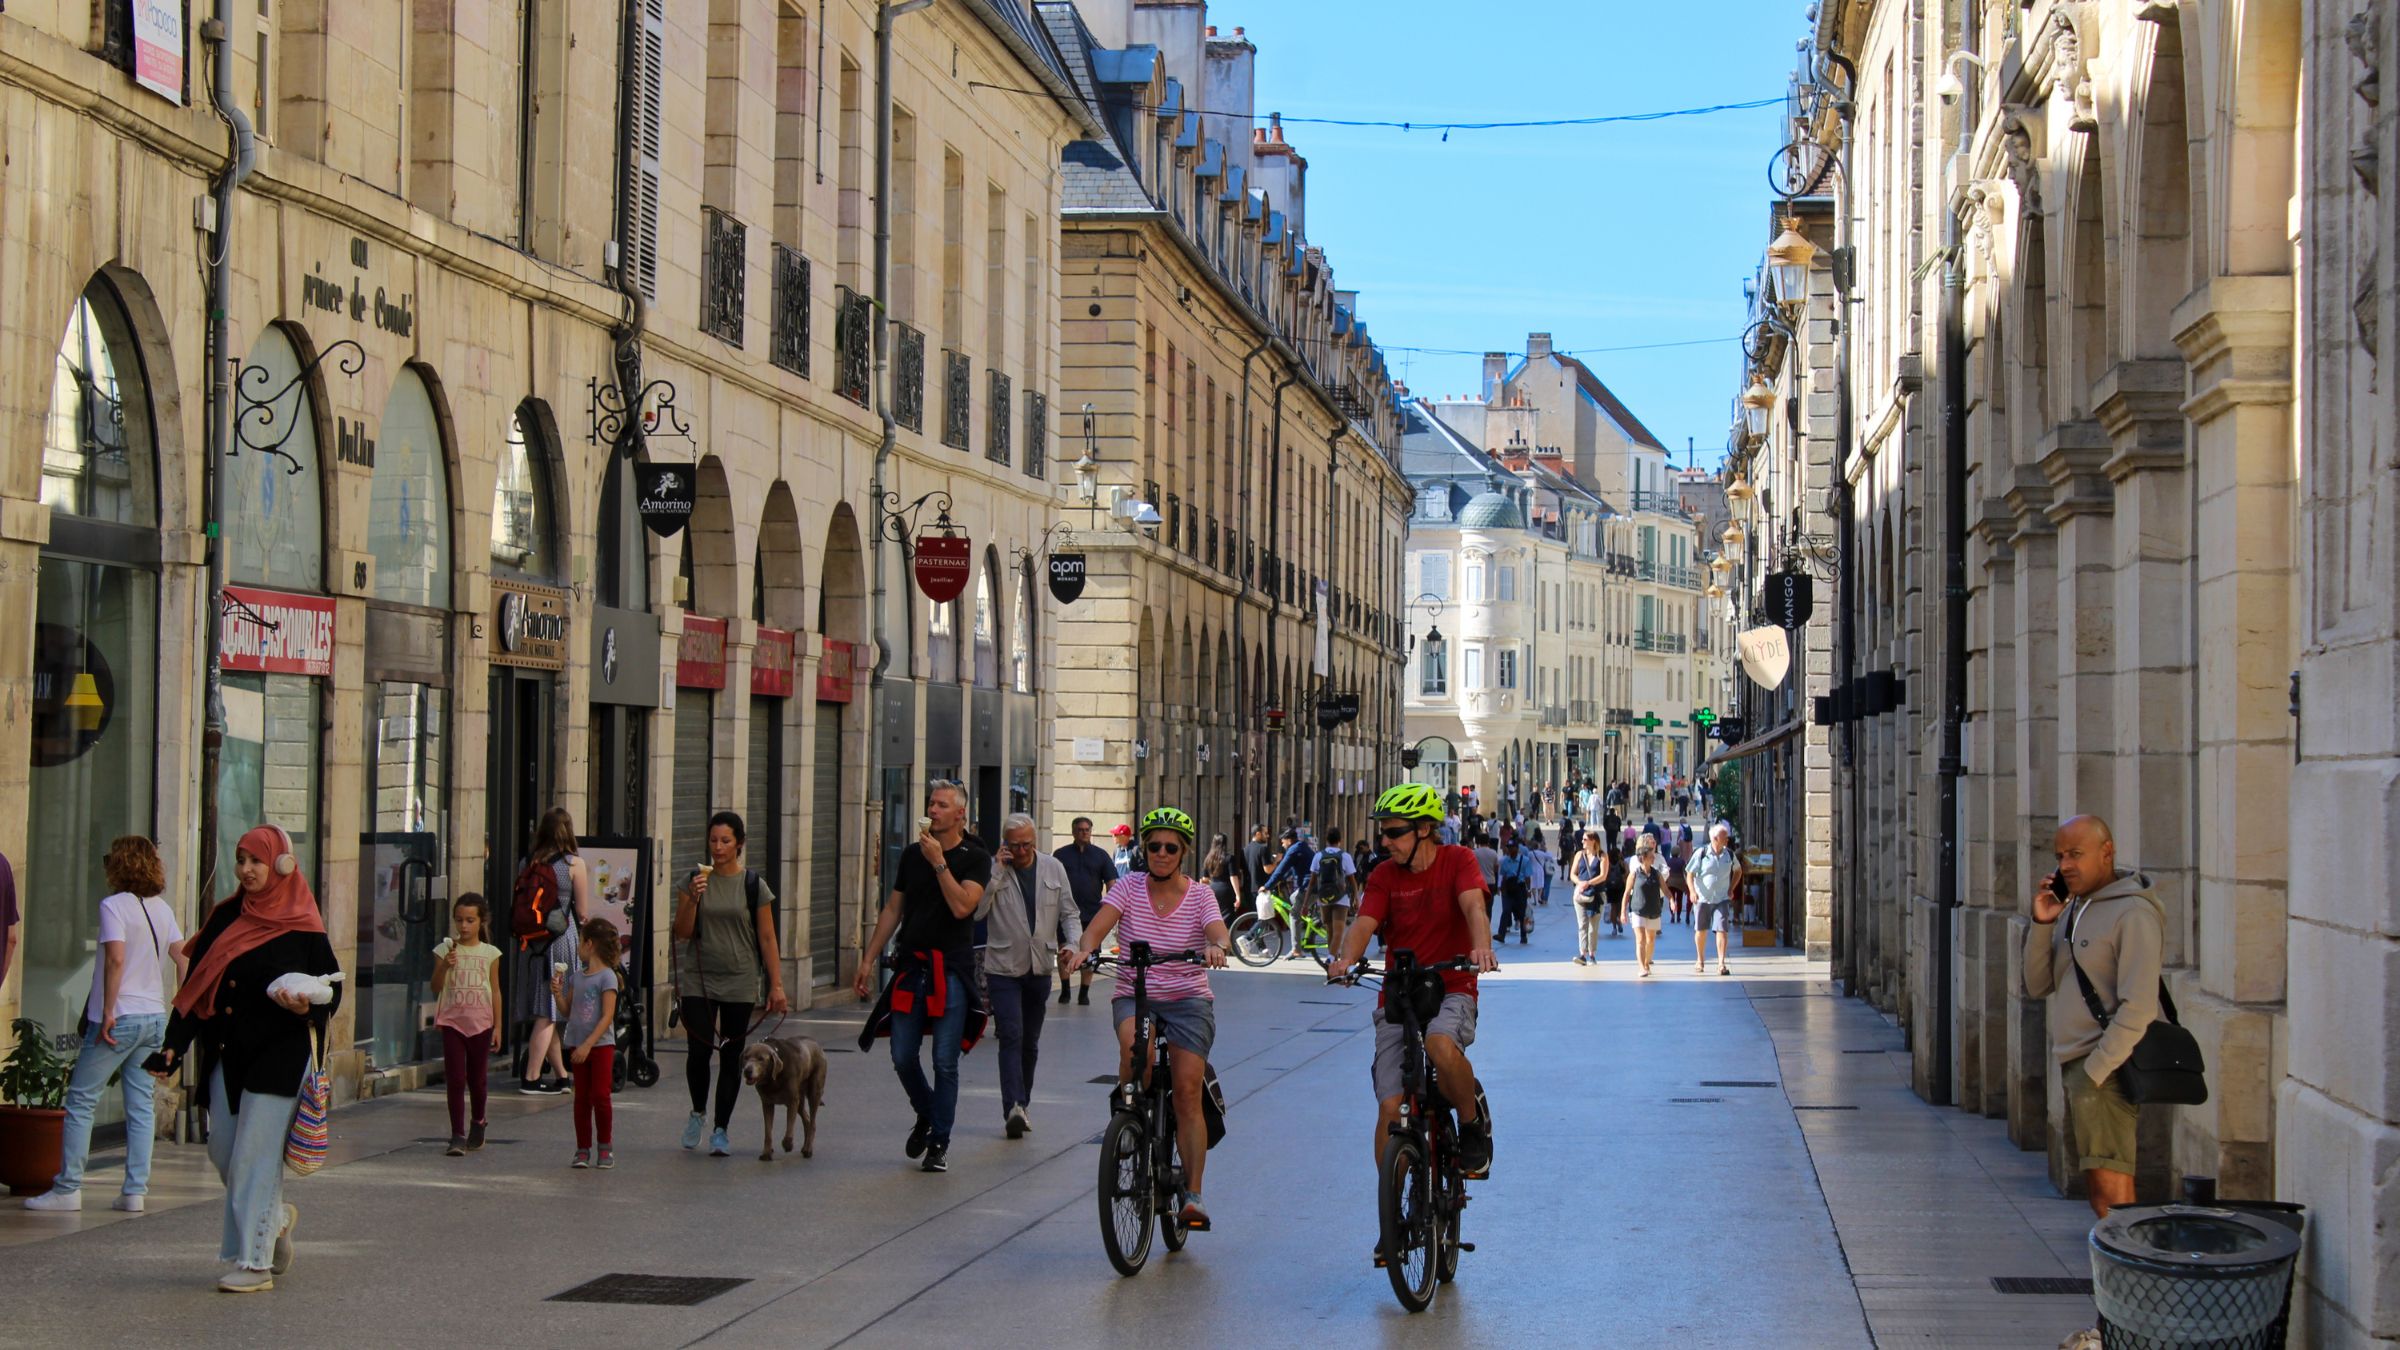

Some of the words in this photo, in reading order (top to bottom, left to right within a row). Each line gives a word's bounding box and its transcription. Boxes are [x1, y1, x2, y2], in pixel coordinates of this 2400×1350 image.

[351, 236, 369, 270] au
[301, 260, 344, 318] prince
[349, 275, 366, 323] de
[374, 285, 413, 338] Condé
[640, 497, 692, 510] Amorino
[354, 560, 367, 590] 88
[918, 558, 967, 567] PASTERNAK
[1050, 561, 1084, 577] apm
[521, 593, 563, 641] Amorino
[1784, 576, 1794, 629] MANGO
[220, 600, 261, 657] OCAUX
[262, 604, 333, 662] DISPONIBLES
[1743, 639, 1785, 664] CLYDE
